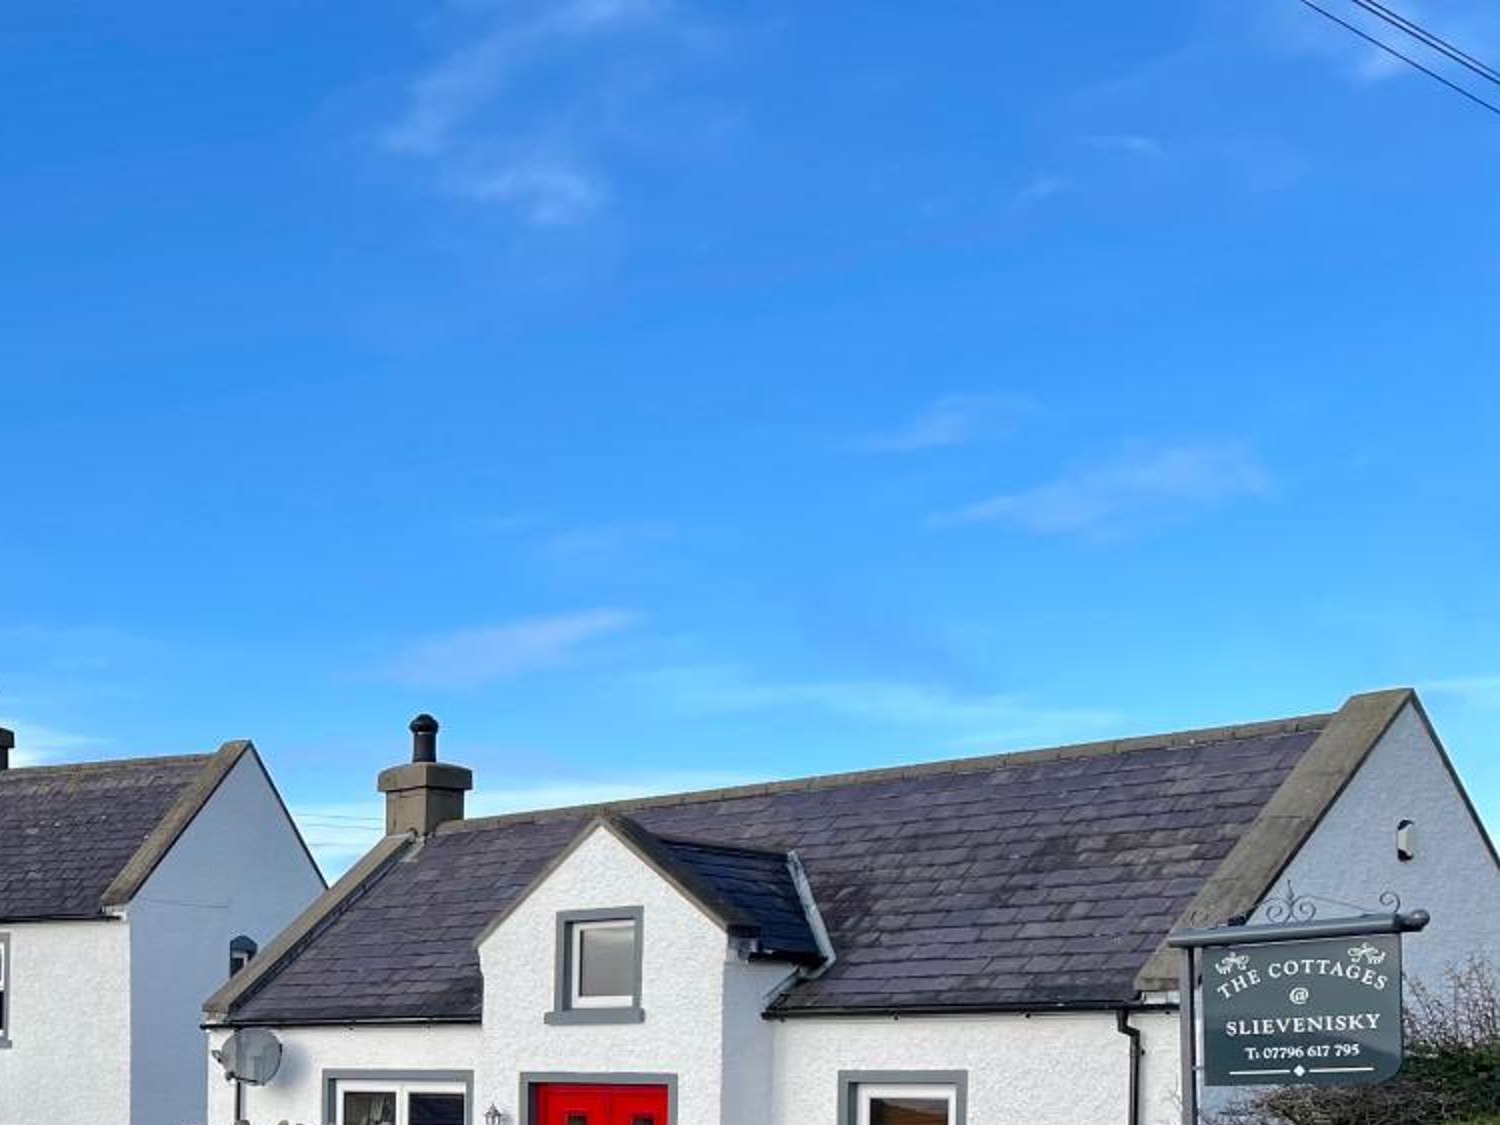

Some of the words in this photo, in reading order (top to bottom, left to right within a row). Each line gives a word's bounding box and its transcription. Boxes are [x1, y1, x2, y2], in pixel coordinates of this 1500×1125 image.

[1217, 970, 1261, 999] THE
[1268, 960, 1388, 990] COTTAGES
[1289, 987, 1309, 1005] @
[1226, 1013, 1380, 1036] SLIEVENISKY
[1263, 1045, 1304, 1059] 07796
[1307, 1044, 1331, 1057] 617
[1334, 1043, 1360, 1057] 795
